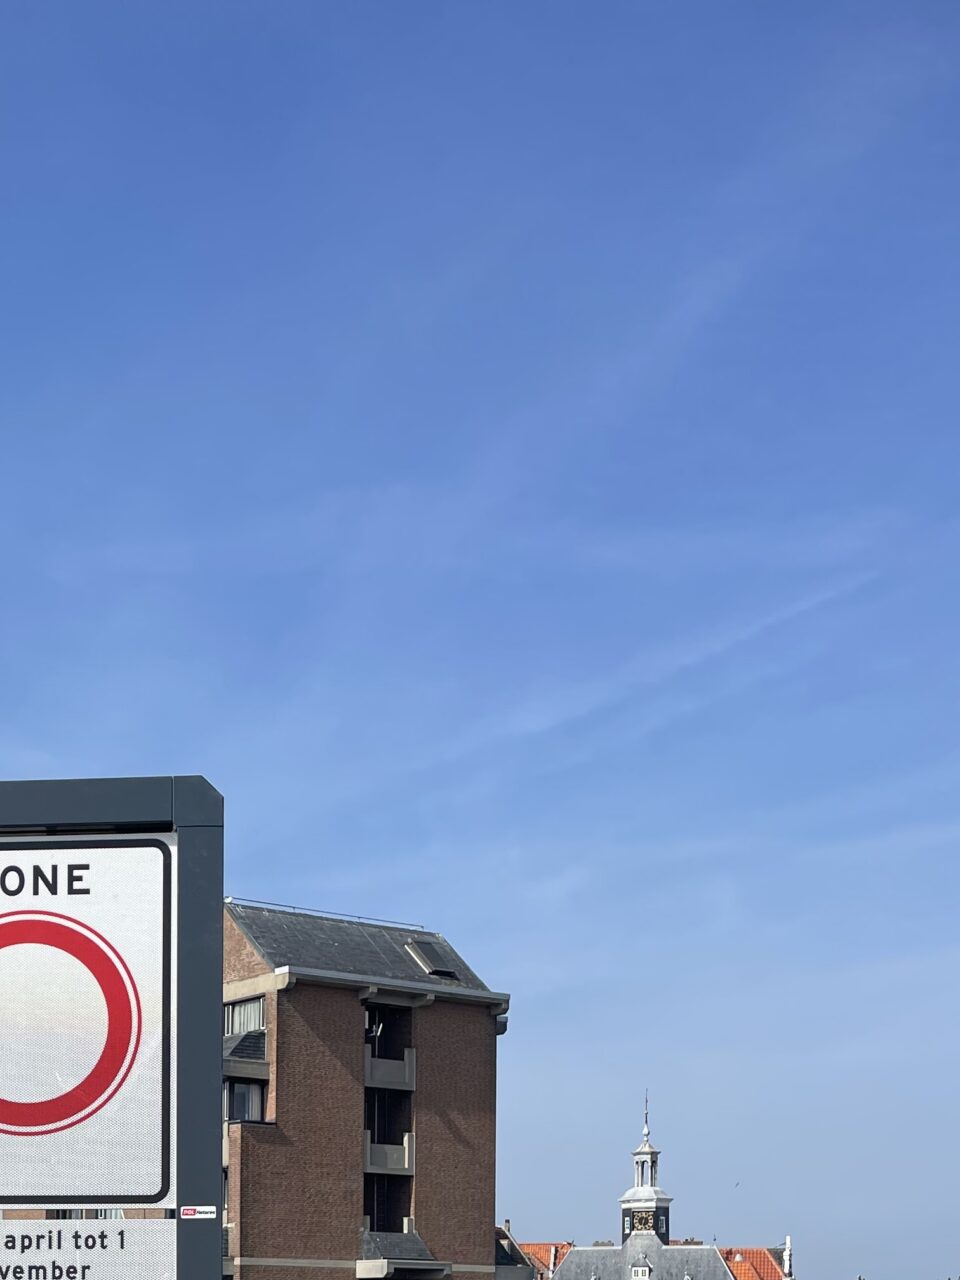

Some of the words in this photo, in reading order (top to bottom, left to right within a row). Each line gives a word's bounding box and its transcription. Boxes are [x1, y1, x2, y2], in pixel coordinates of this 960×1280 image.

[4, 1230, 62, 1254] april
[72, 1230, 108, 1250] tot
[117, 1230, 126, 1250] 1
